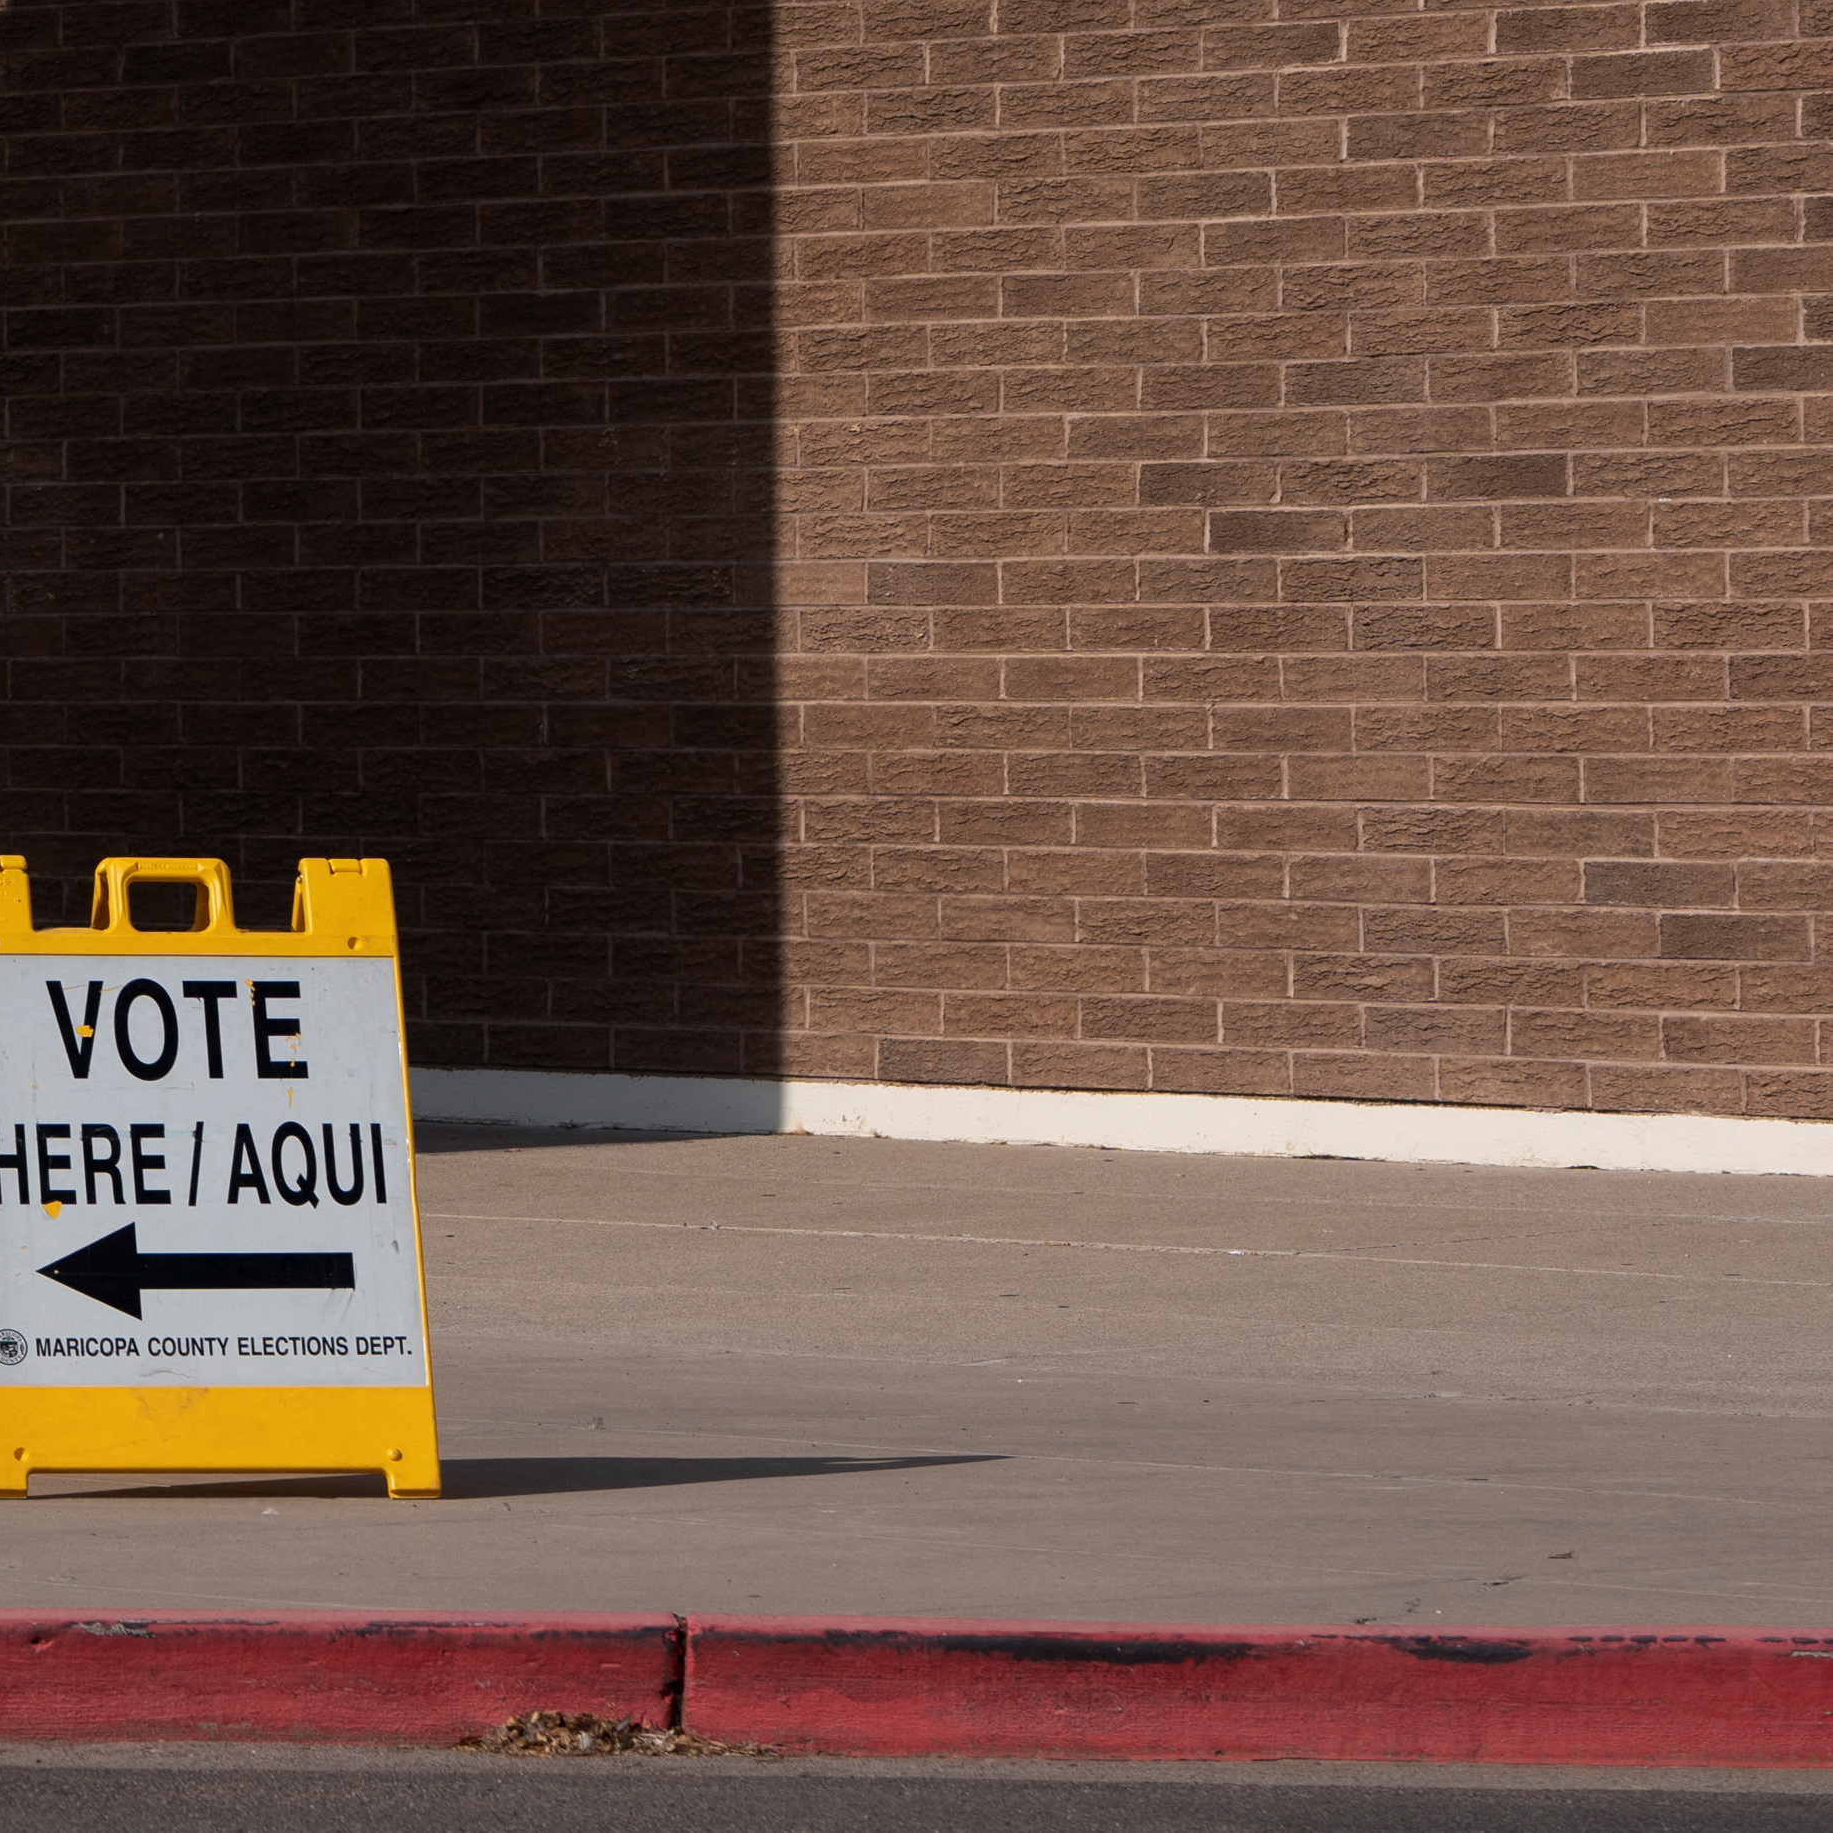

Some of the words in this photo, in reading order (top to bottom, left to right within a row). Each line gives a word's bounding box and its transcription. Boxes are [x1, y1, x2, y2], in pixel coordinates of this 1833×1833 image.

[46, 978, 309, 1082] VOTE
[227, 1121, 387, 1209] AQUI
[35, 1337, 140, 1357] MARICOPA
[147, 1337, 229, 1357] COUNTY
[237, 1336, 349, 1356] ELECTIONS
[355, 1335, 413, 1356] DEPT.
